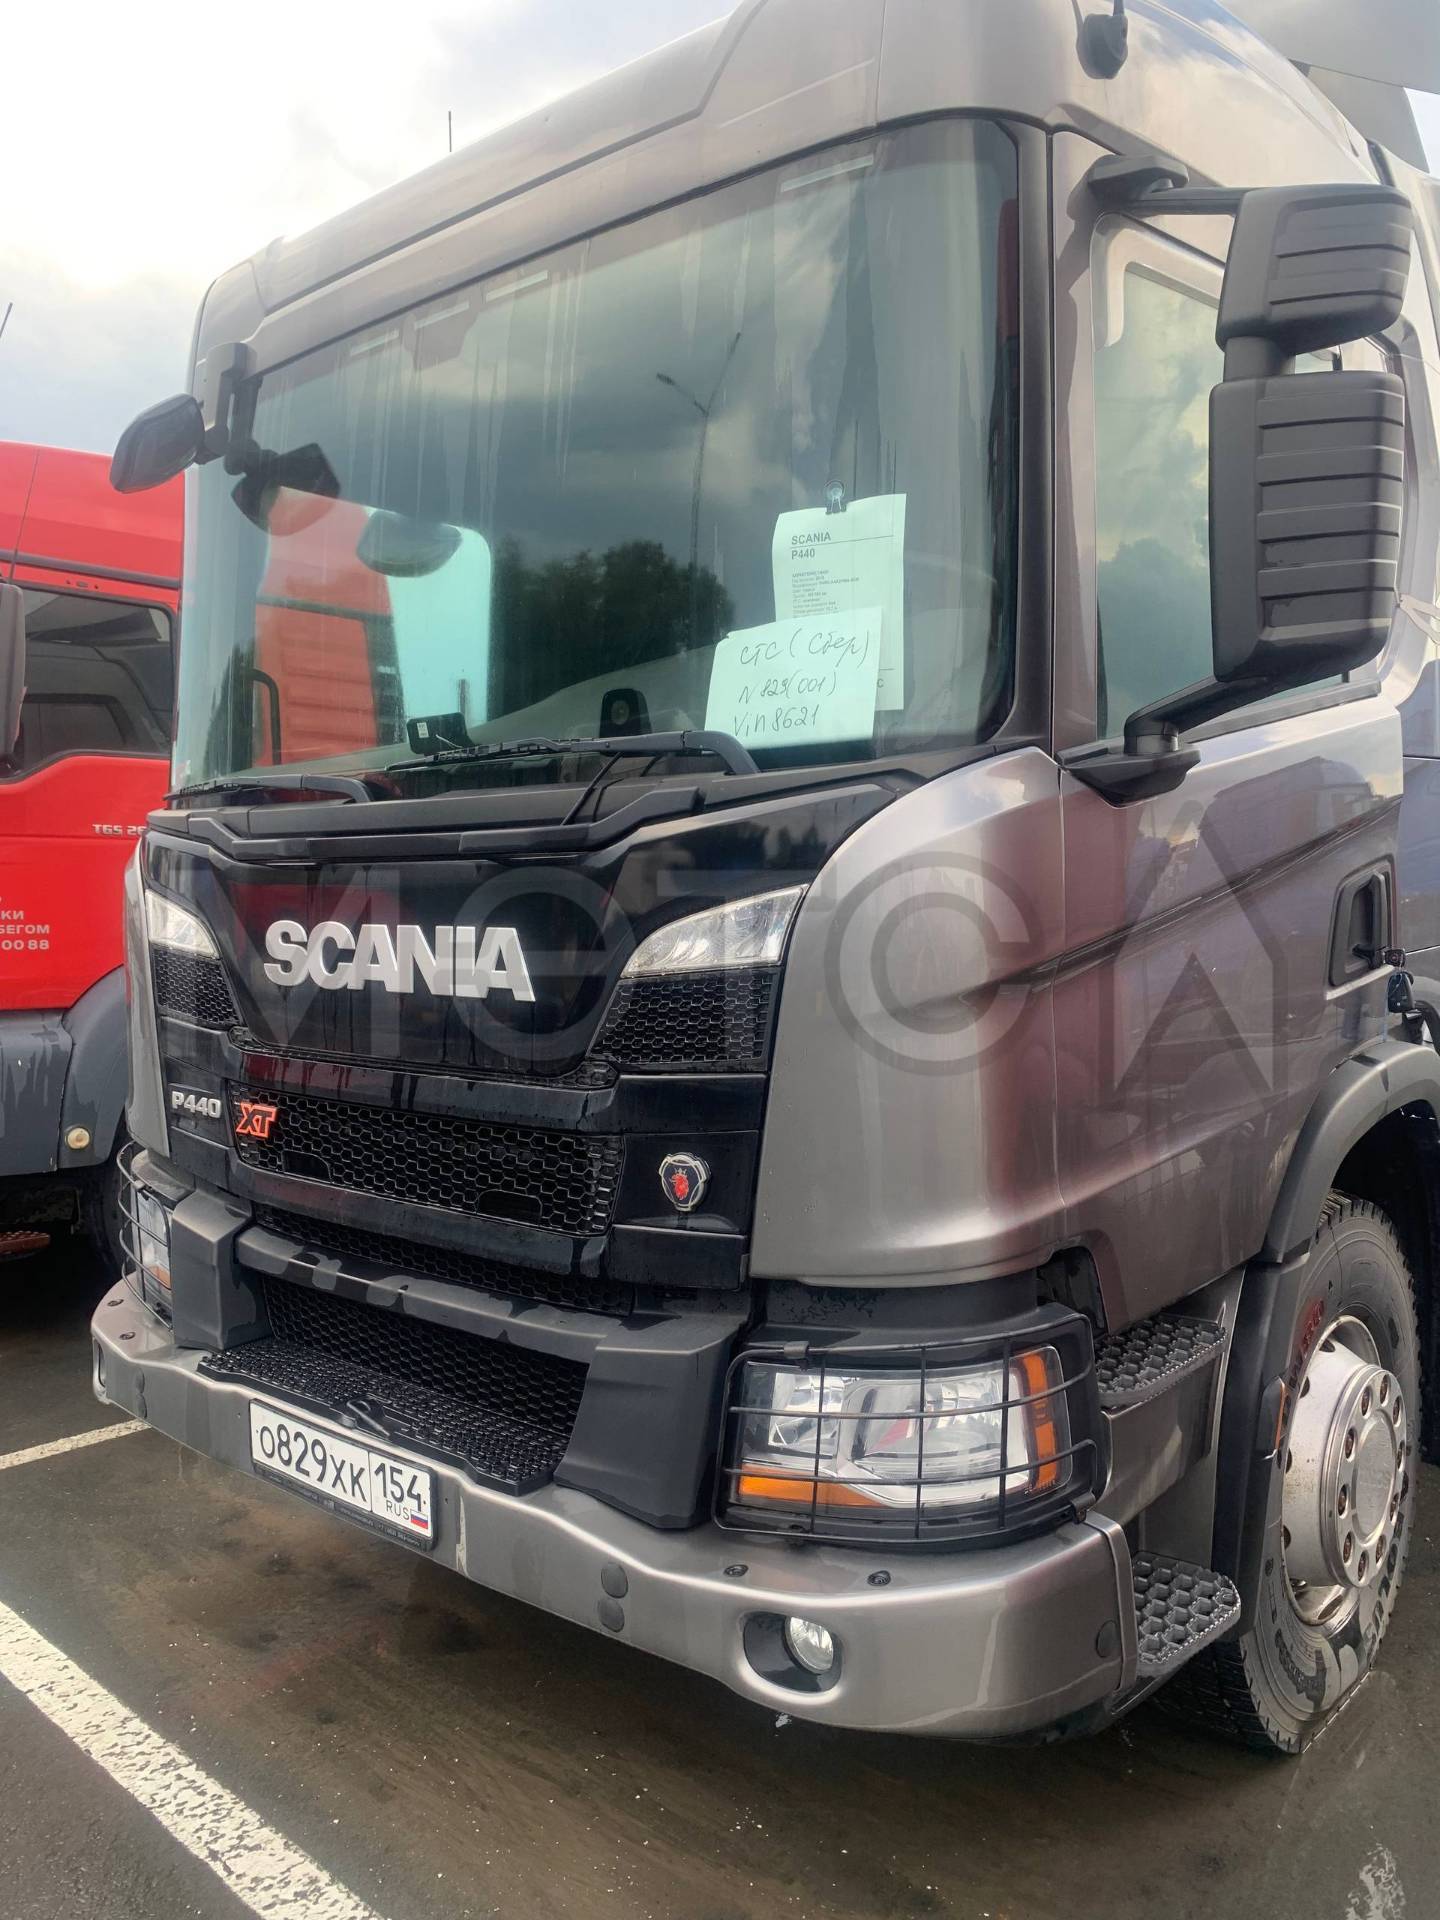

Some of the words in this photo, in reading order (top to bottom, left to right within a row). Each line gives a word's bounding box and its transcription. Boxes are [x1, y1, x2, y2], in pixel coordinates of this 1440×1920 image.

[791, 531, 831, 546] SCANIA
[791, 548, 815, 560] P440
[92, 824, 123, 836] TGS
[27, 939, 50, 951] 88
[263, 919, 536, 1002] SCANIA
[171, 1091, 222, 1119] P440
[235, 1101, 277, 1139] XT
[374, 1462, 421, 1512] 154
[386, 1500, 409, 1520] RUS
